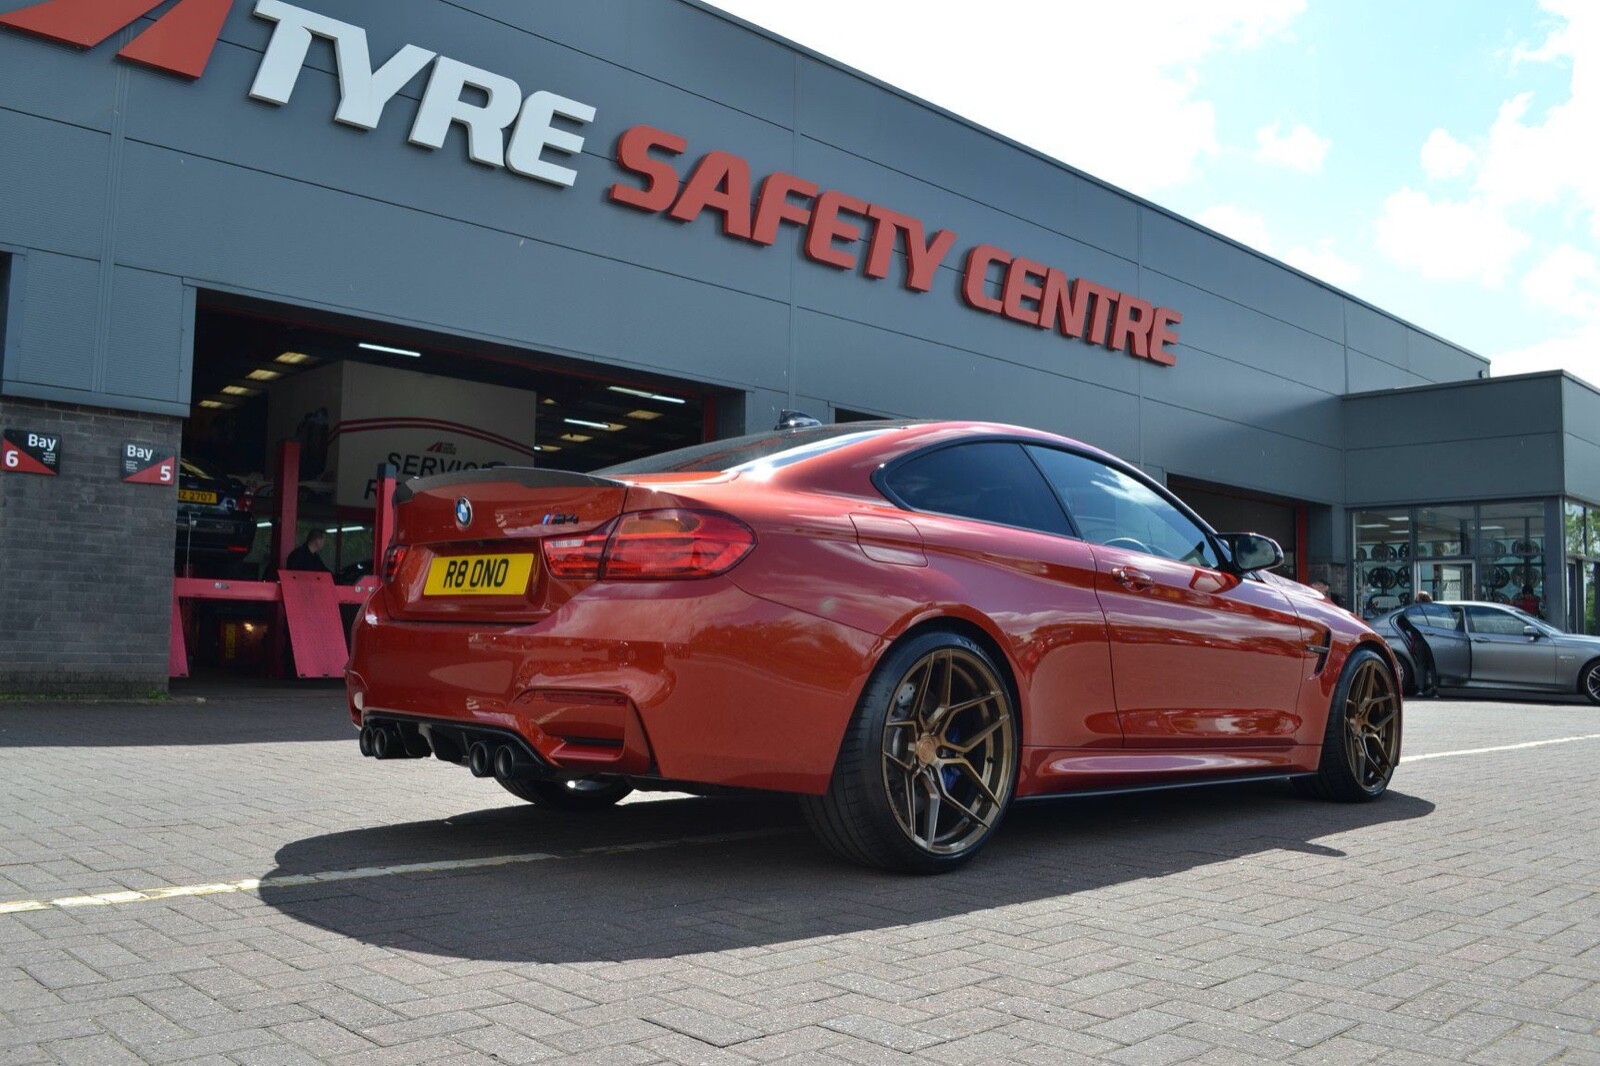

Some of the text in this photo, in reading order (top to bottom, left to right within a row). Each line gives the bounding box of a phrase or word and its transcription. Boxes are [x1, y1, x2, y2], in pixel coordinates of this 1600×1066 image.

[249, 0, 1184, 367] TYRE SAFETY CENTRE
[28, 433, 57, 452] Bay
[5, 450, 19, 468] 6
[127, 444, 153, 461] Bay
[160, 465, 171, 482] 5
[443, 559, 467, 588] R8
